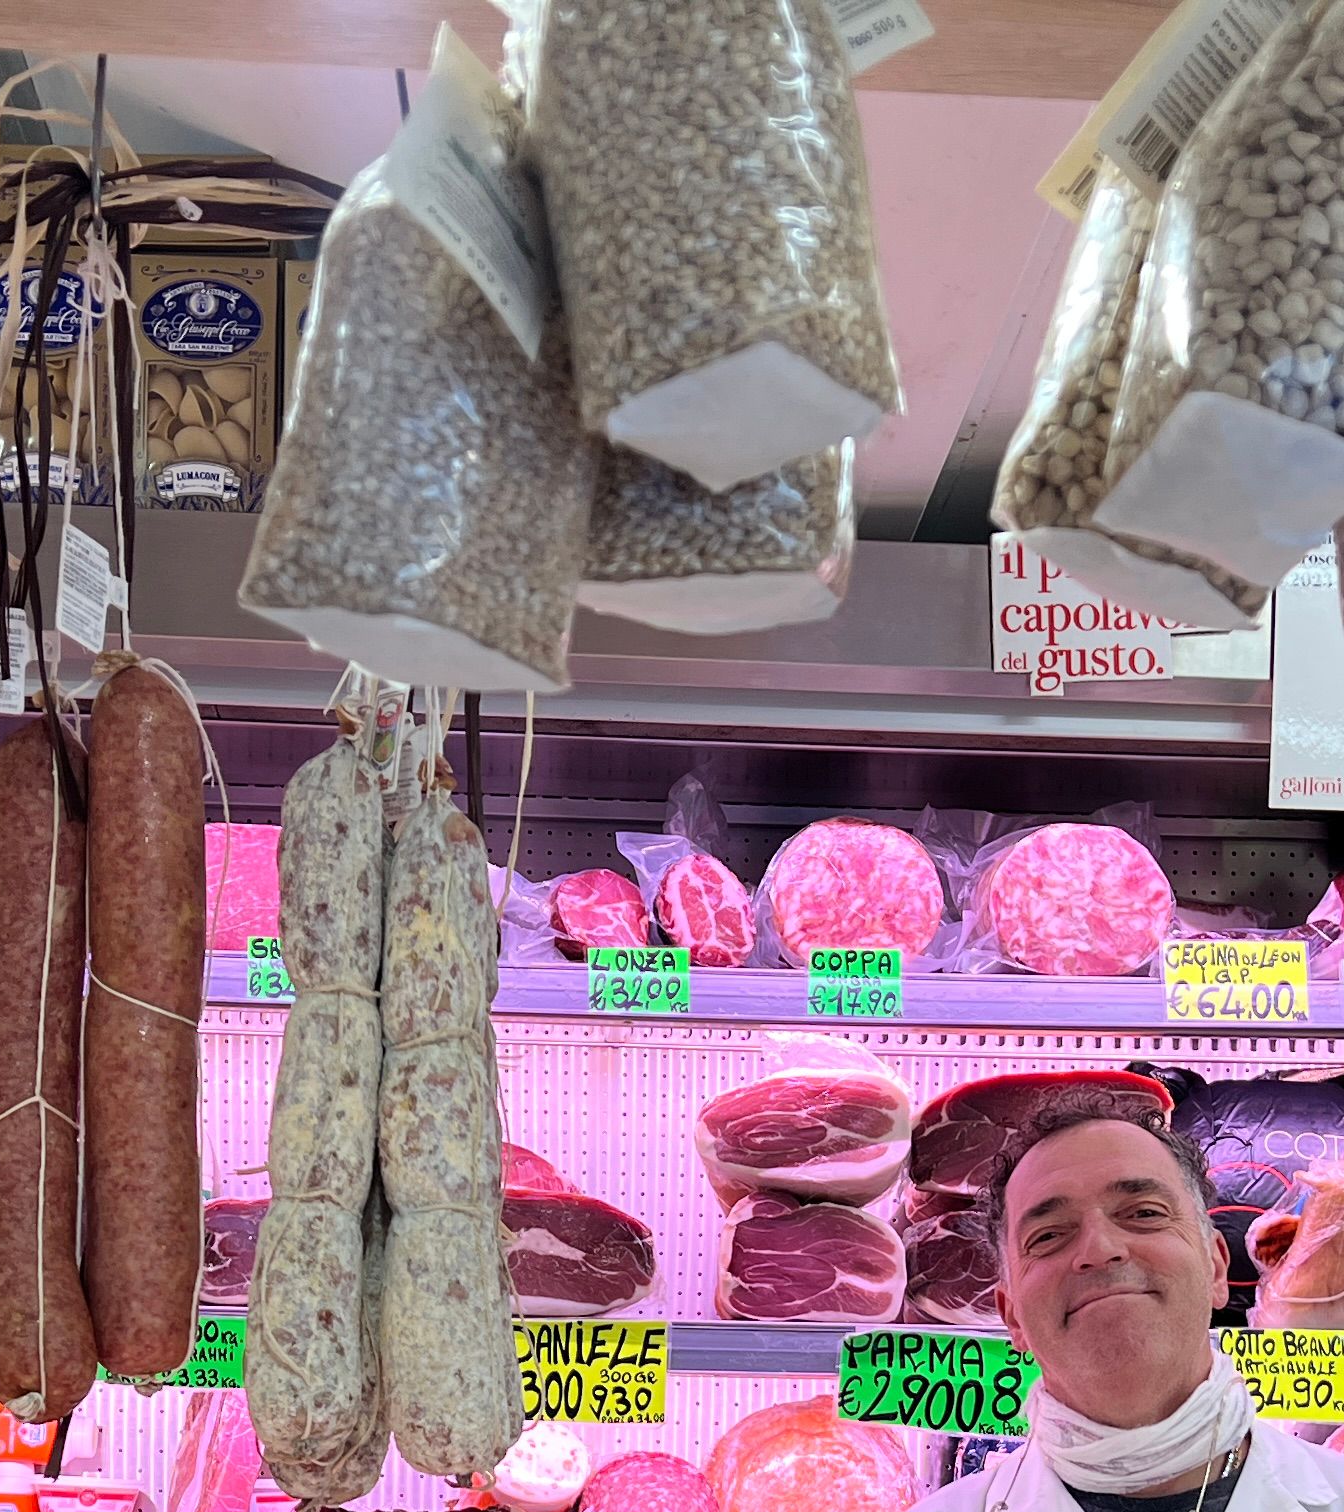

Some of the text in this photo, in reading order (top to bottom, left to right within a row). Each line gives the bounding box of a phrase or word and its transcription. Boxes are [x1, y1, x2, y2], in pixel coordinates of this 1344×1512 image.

[176, 471, 221, 483] LUMACONI
[999, 596, 1197, 645] capolavo
[1001, 643, 1165, 693] del gusto.
[1280, 775, 1343, 800] galloni
[590, 949, 675, 973] LONZA
[811, 951, 893, 976] COPPA
[842, 1332, 985, 1380] PARMA
